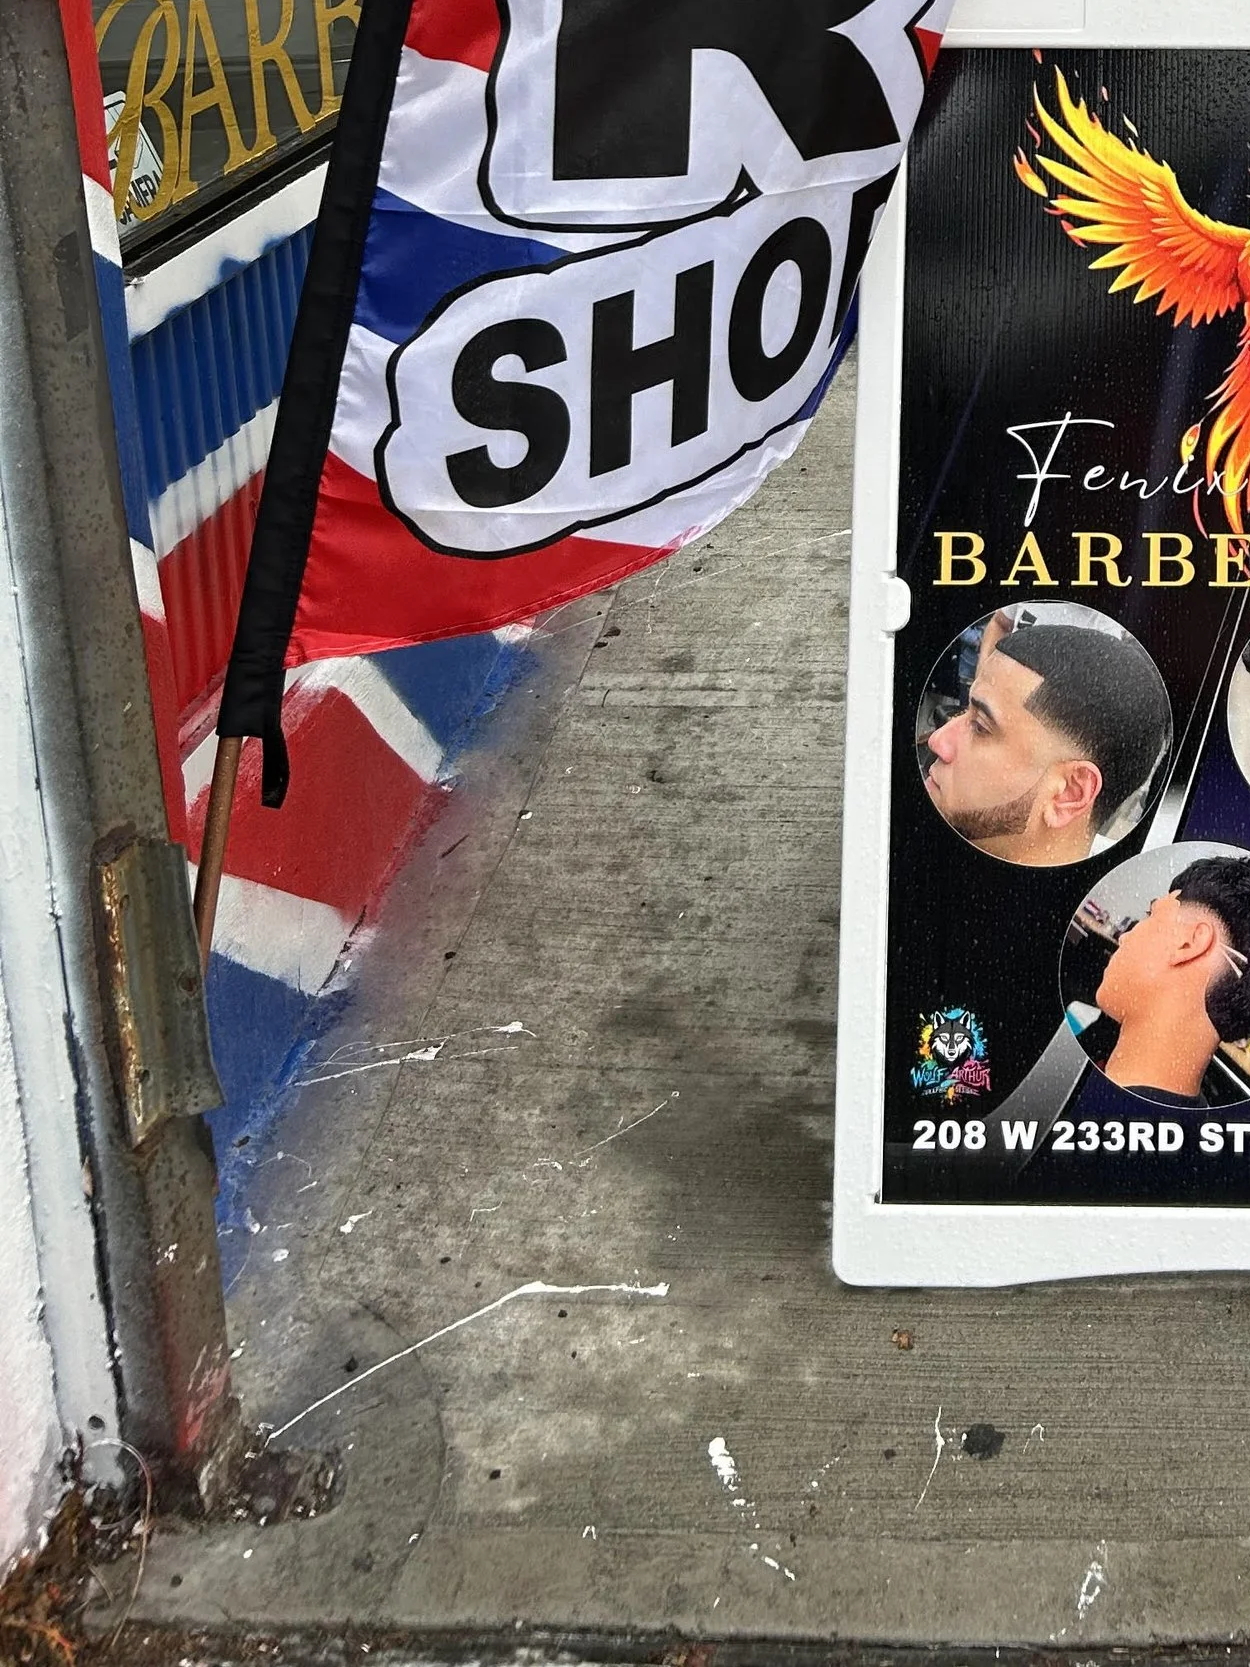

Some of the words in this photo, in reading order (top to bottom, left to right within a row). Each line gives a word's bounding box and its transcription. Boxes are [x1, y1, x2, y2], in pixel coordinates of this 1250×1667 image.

[1006, 411, 1249, 528] Fenix
[910, 1066, 948, 1088] WOLF
[945, 1066, 992, 1091] ARTHUR
[912, 1120, 986, 1150] 208
[1001, 1121, 1038, 1151] W
[1052, 1121, 1184, 1153] 233RD
